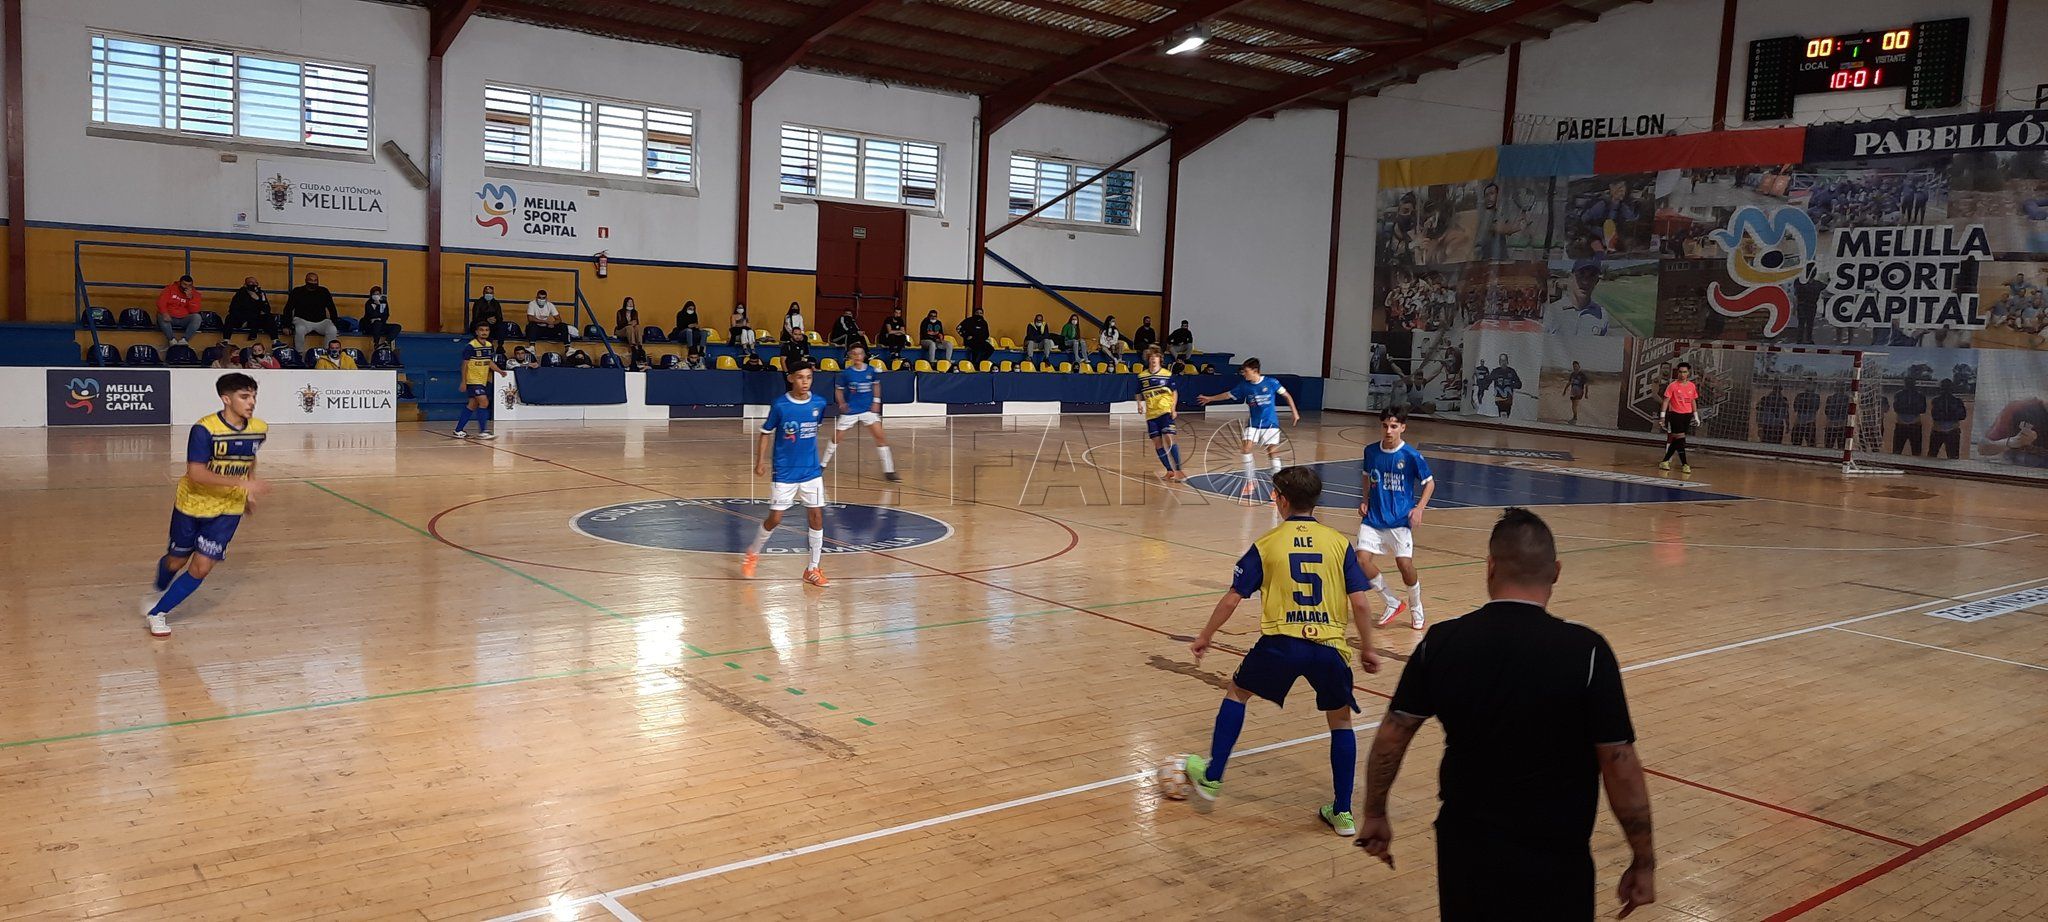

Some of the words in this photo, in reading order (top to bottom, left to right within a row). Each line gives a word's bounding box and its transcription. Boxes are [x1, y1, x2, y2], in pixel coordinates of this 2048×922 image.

[1806, 38, 1832, 58] 00
[1882, 30, 1910, 51] 00
[1853, 46, 1859, 58] 1
[1875, 53, 1907, 64] VISITANTE
[1800, 61, 1829, 72] LOCAL
[1830, 68, 1882, 89] 10:01
[1557, 114, 1665, 140] PABELLON
[300, 182, 331, 192] CIUDAD
[333, 186, 382, 196] AUTÓNOMA
[302, 192, 383, 213] MELILLA
[524, 197, 577, 212] MELILLA
[524, 210, 568, 224] SPORT
[523, 222, 577, 238] CAPITAL
[1836, 227, 1992, 258] MELILLA
[1835, 262, 1961, 291] SPORT
[1832, 293, 1987, 326] CAPITAL
[105, 384, 154, 394] MELILLA
[105, 393, 145, 402] SPORT
[327, 397, 392, 409] MELILLA
[105, 402, 155, 412] CAPITAL
[1293, 536, 1314, 548] ALE
[1288, 552, 1323, 606] 5
